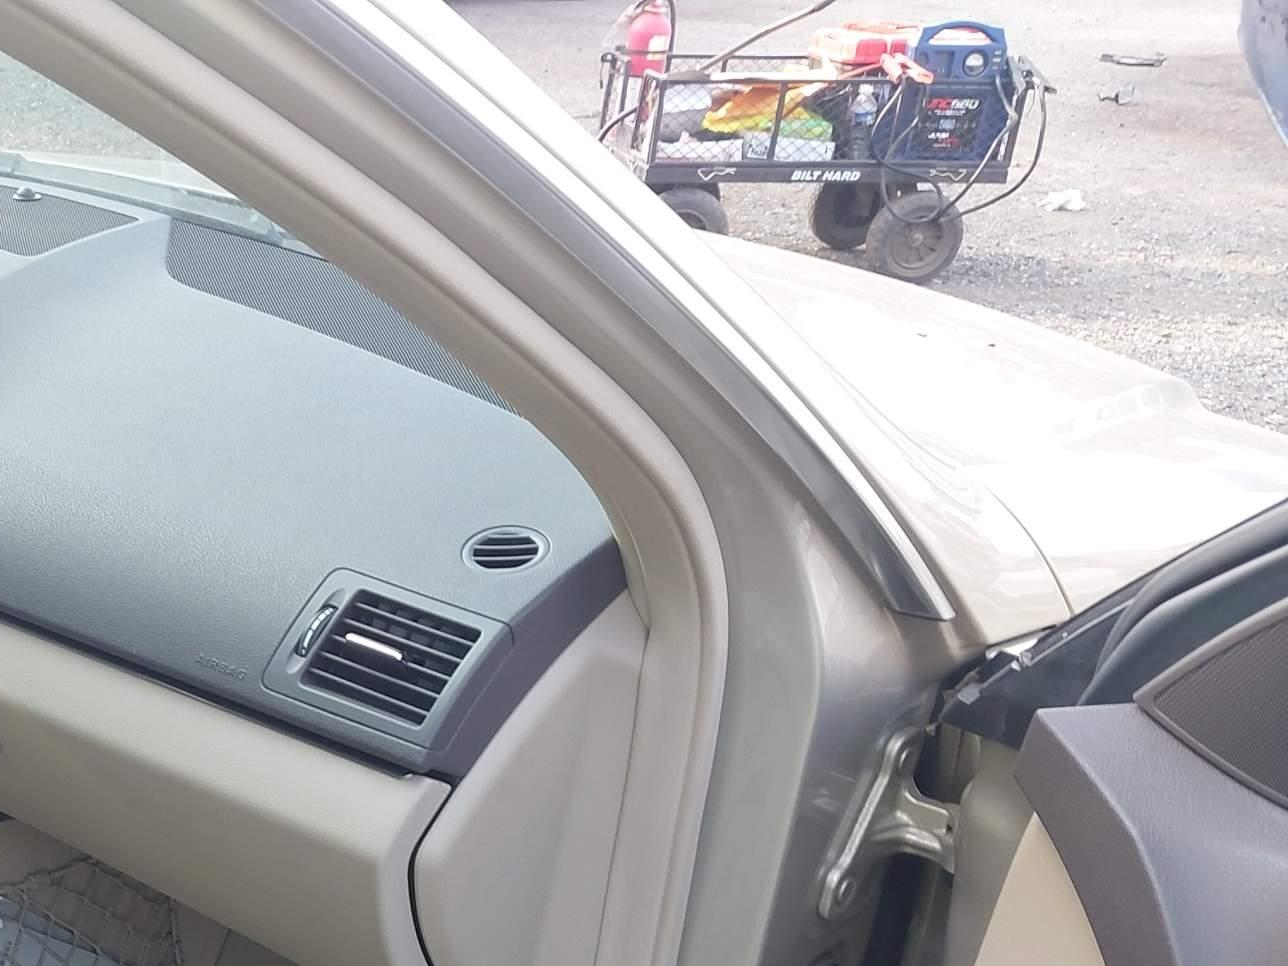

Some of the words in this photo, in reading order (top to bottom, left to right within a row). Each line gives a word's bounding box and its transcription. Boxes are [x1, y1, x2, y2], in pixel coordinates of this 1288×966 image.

[790, 169, 822, 181] BILT
[822, 170, 861, 182] HARD
[196, 653, 246, 680] AIRBAG
